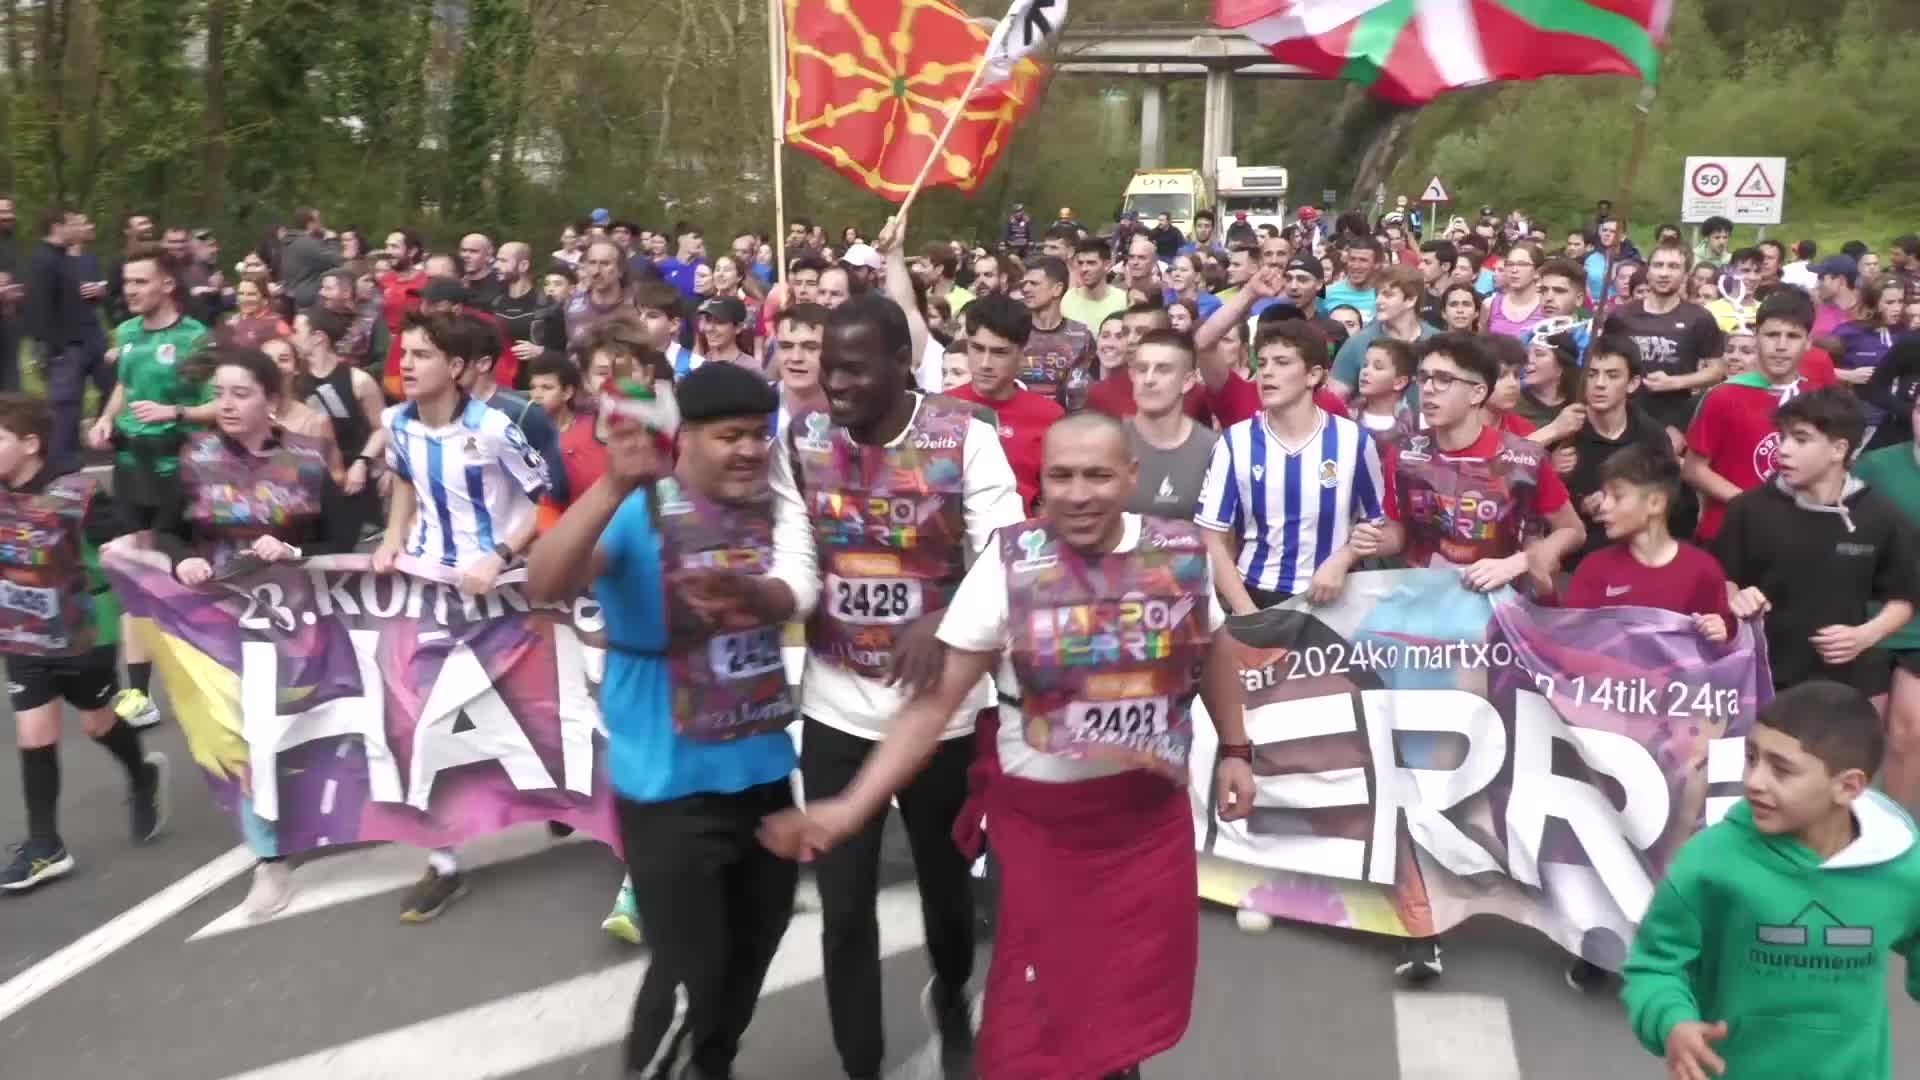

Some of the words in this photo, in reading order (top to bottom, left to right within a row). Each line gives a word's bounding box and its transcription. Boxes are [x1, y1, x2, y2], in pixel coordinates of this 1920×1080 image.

[1701, 175, 1720, 185] 50
[838, 581, 909, 617] 2428
[1285, 640, 1399, 680] 2024ko
[1571, 675, 1657, 715] 14tik
[1667, 681, 1740, 717] 24ra
